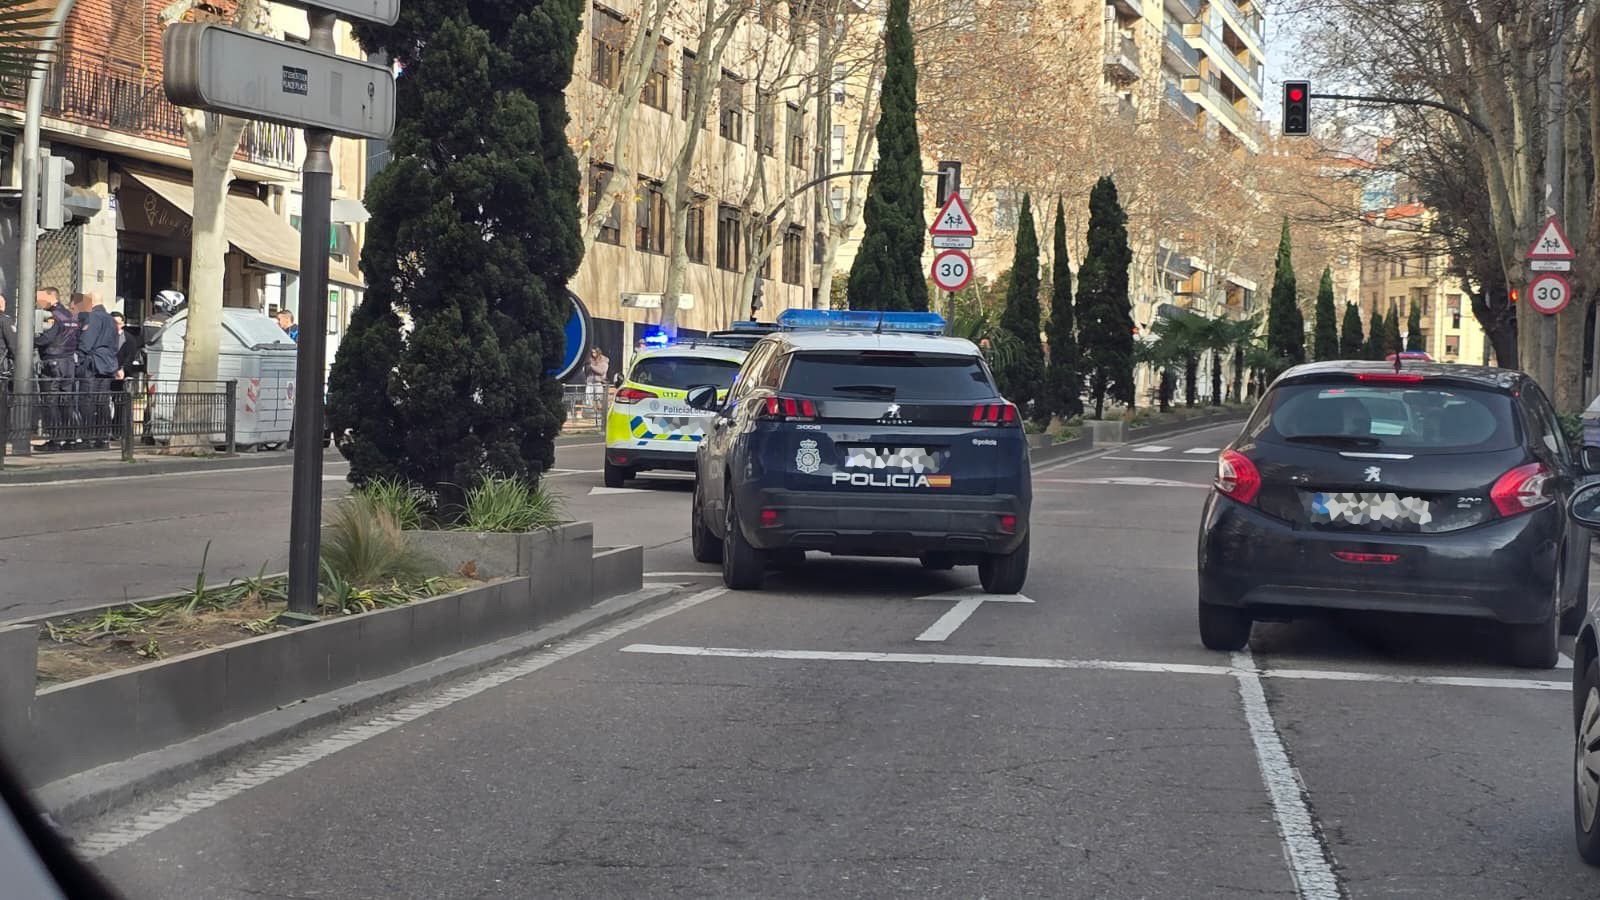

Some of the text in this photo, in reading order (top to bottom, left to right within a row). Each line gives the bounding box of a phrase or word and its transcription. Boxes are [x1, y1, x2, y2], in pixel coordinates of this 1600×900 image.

[941, 263, 964, 277] 30
[1537, 287, 1561, 300] 30
[831, 472, 931, 488] POLICIA
